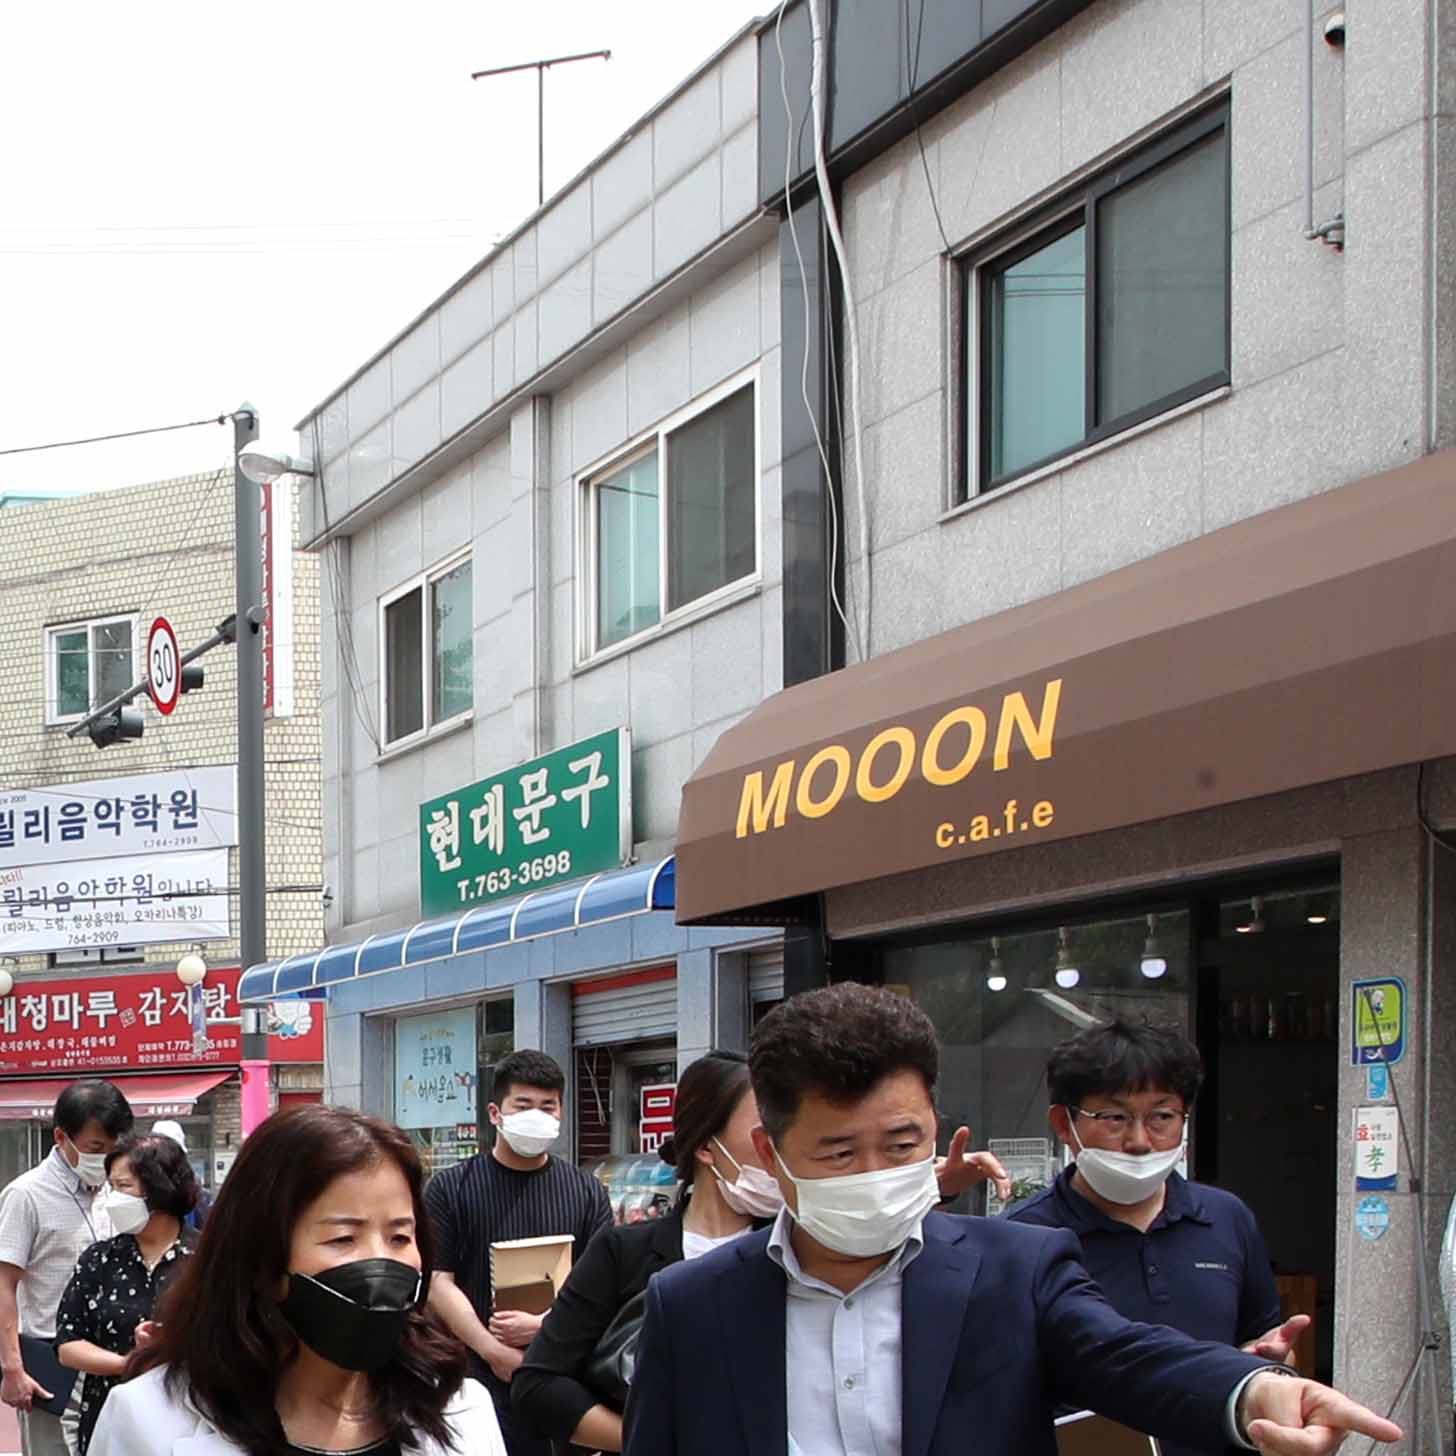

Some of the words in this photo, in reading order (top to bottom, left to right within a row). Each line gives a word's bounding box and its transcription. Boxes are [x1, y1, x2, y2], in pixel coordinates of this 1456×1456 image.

[154, 643, 172, 688] 30
[735, 679, 1063, 839] MOOON
[426, 750, 609, 873] 현대문구
[935, 798, 1055, 850] c.a.f.e
[457, 850, 571, 901] T.763-3698
[68, 931, 120, 945] 764-2909
